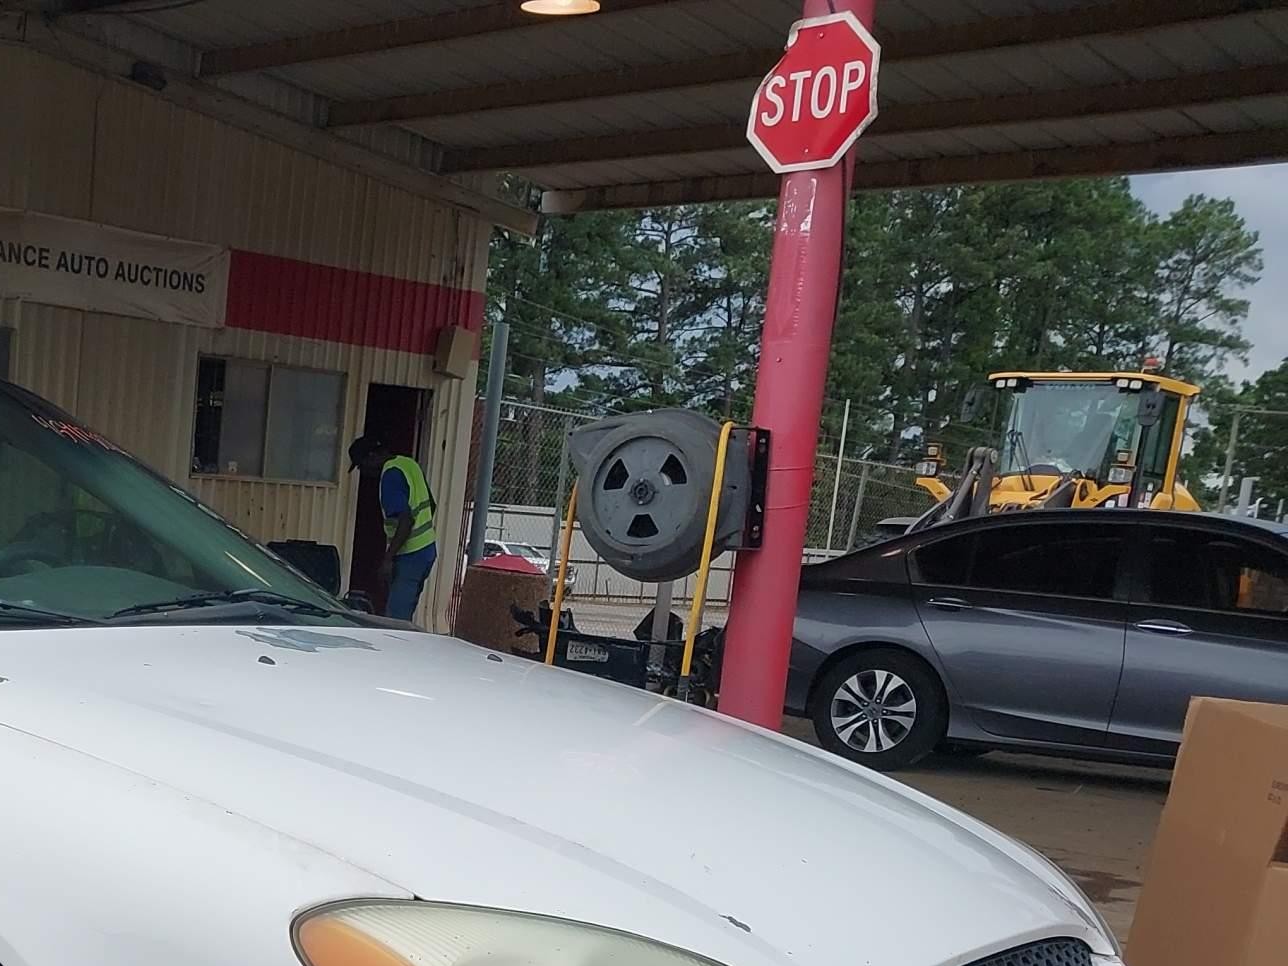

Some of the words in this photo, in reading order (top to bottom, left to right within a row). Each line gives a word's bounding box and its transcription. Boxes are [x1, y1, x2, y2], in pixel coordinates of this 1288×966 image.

[762, 60, 866, 127] STOP
[56, 250, 109, 279] AUTO
[114, 256, 206, 294] AUCTIONS
